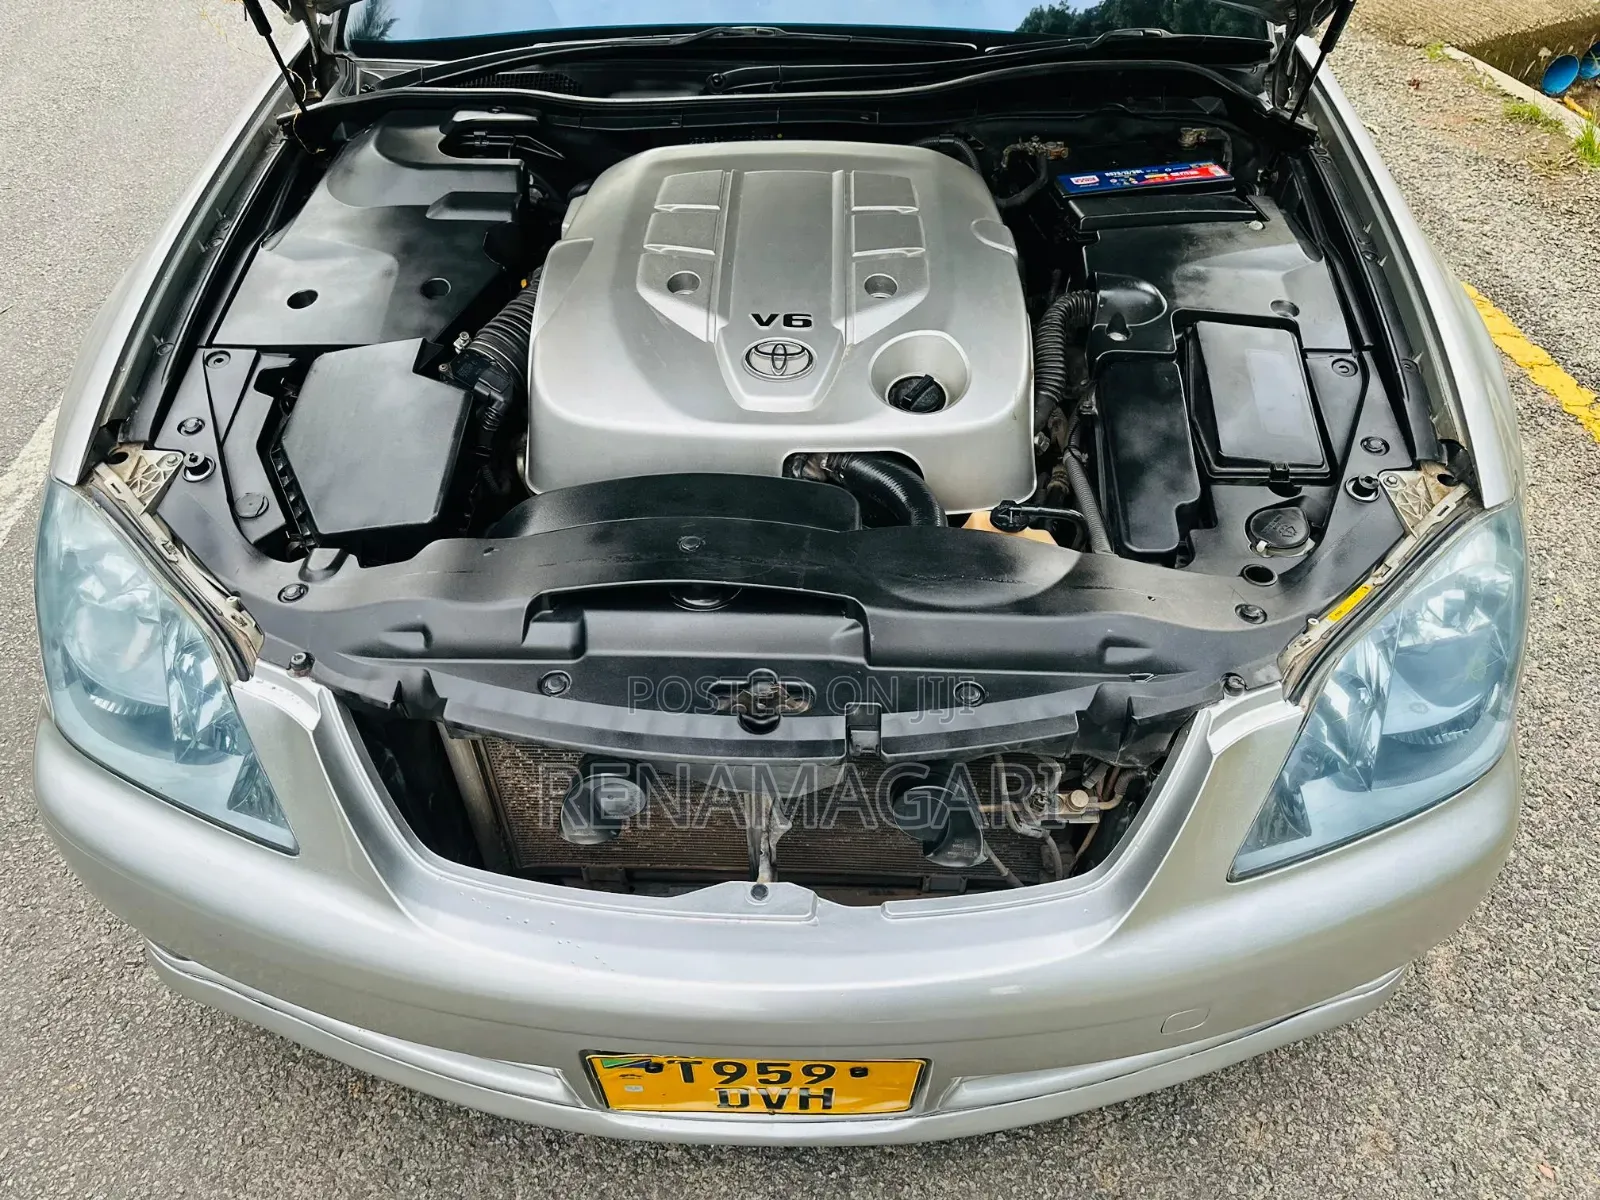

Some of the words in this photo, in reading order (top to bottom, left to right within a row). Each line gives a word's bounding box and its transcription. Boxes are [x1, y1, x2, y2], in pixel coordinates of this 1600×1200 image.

[750, 313, 813, 329] V6
[667, 1061, 836, 1085] T959
[715, 1087, 835, 1110] DVH
